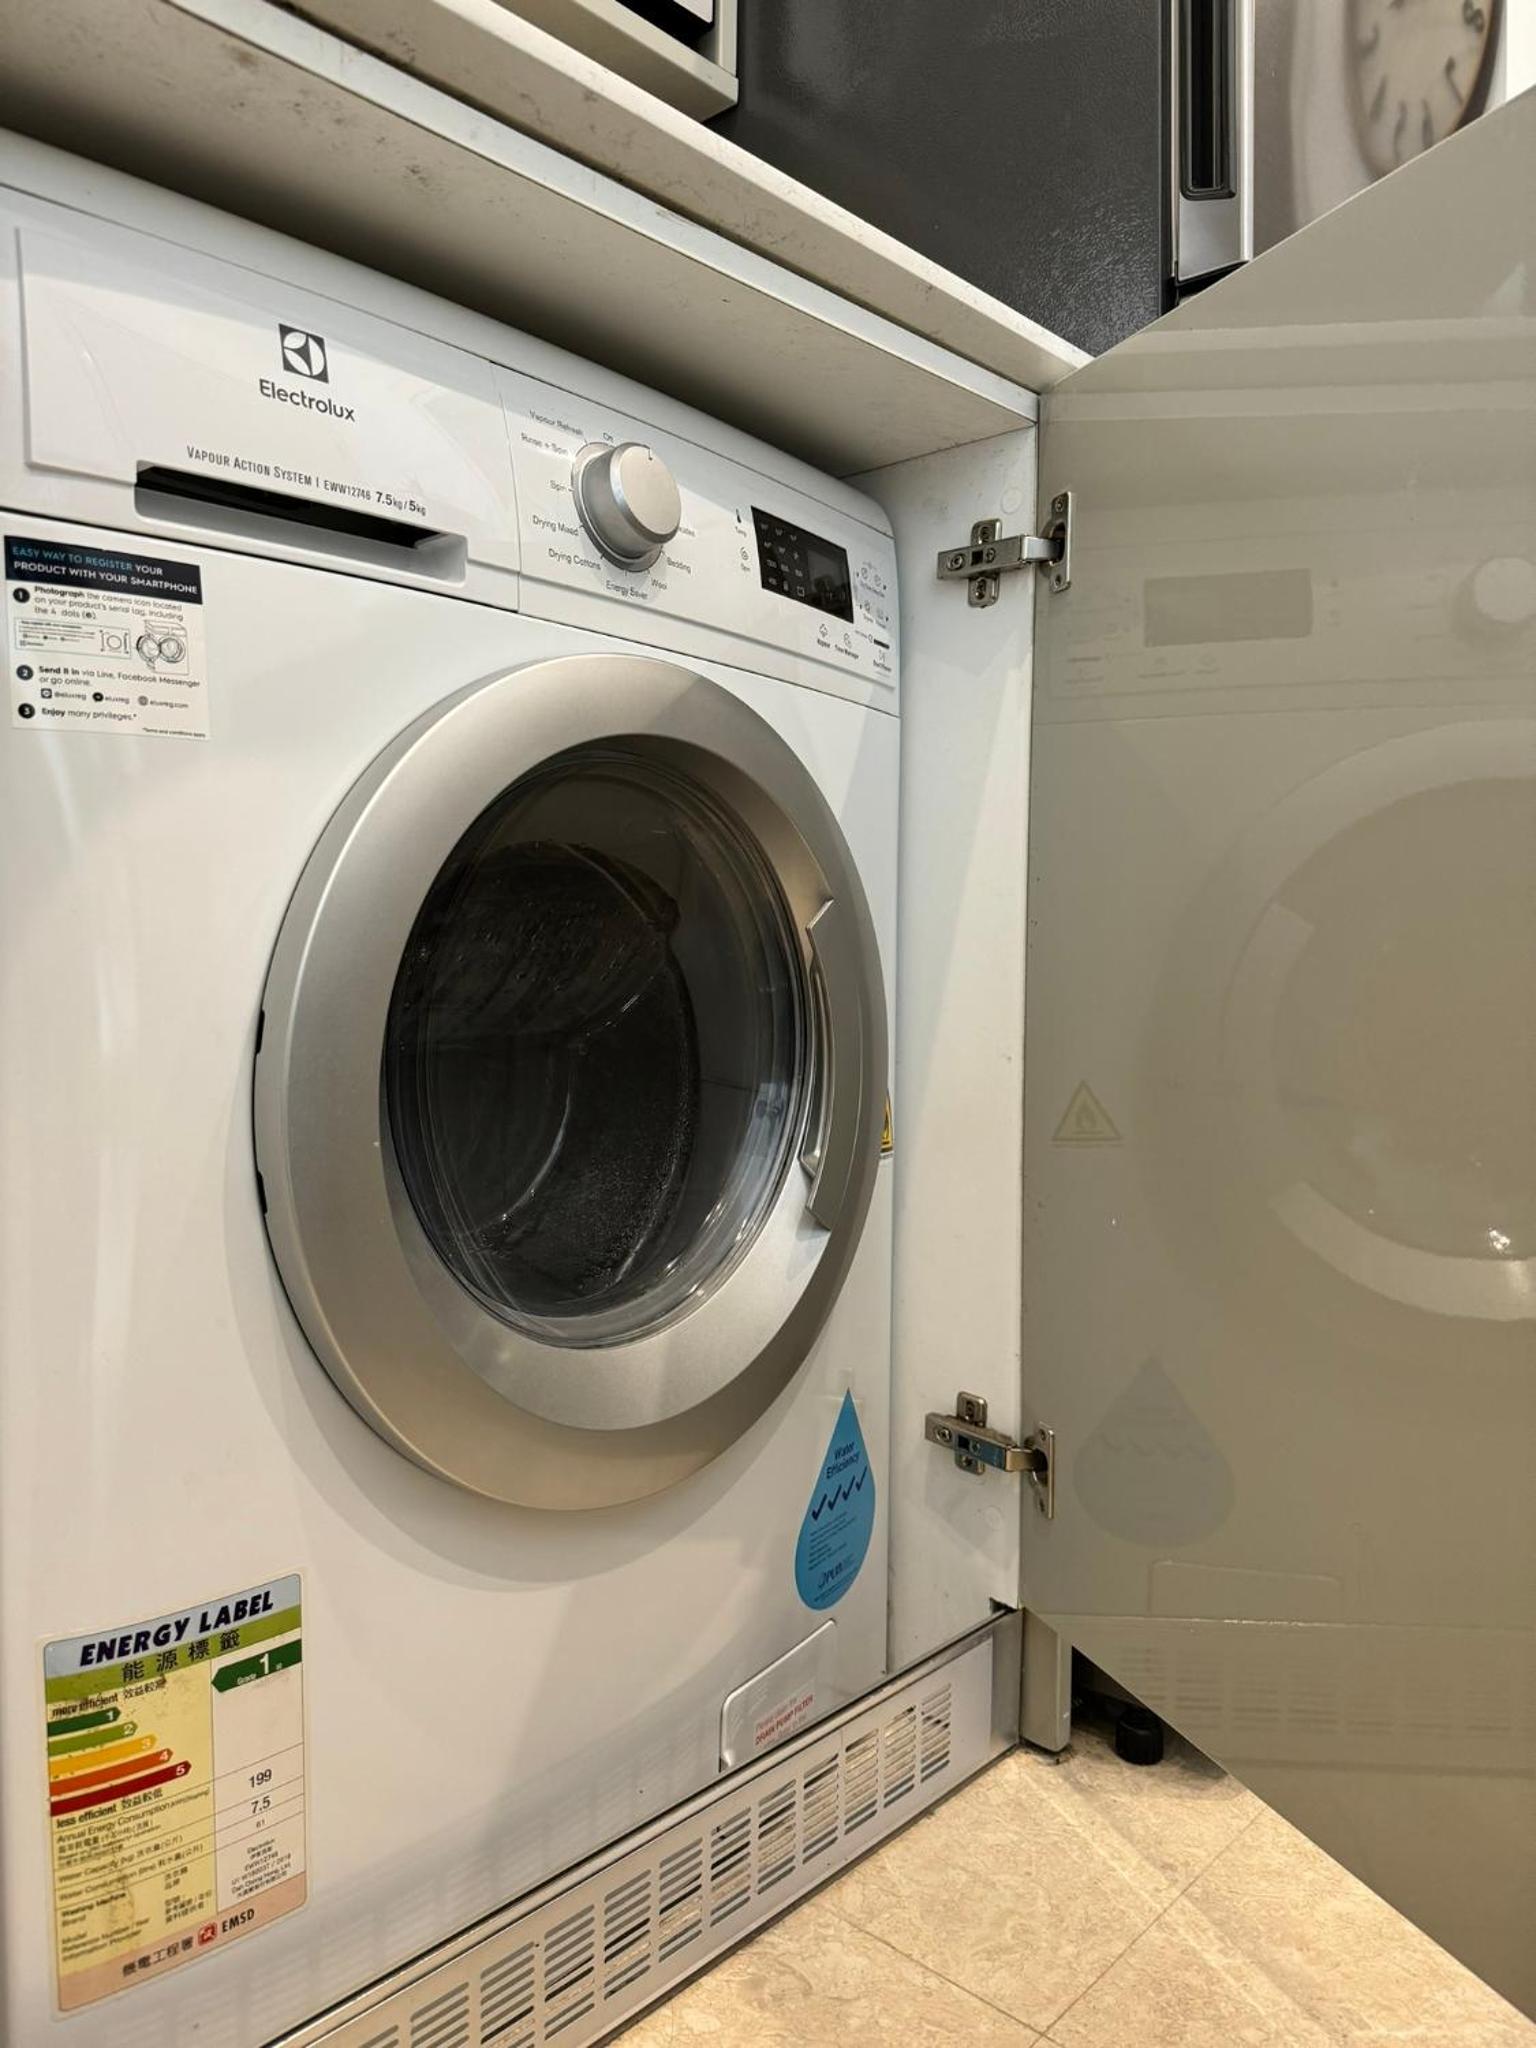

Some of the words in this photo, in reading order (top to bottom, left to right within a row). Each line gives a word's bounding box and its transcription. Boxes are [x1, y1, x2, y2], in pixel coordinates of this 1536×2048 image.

[259, 378, 356, 422] Electrolux
[324, 479, 371, 501] EWW12746
[533, 514, 556, 531] Drying
[12, 546, 40, 558] EASY
[42, 550, 66, 561] WAY
[68, 554, 83, 564] TO
[85, 556, 133, 571] REGISTER
[135, 564, 164, 576] YOUR
[548, 548, 572, 565] Drying
[14, 561, 67, 575] PRODUCT
[68, 568, 97, 579] WITH
[98, 572, 128, 584] YOUR
[130, 576, 198, 595] SMARTPHONE
[34, 586, 86, 598] Photograph
[606, 580, 629, 597] Energy
[39, 665, 61, 675] Send
[118, 672, 157, 683] Facebook
[159, 676, 200, 688] Messenger
[42, 707, 65, 717] Enjoy
[68, 710, 91, 719] many
[834, 1441, 855, 1460] Water
[826, 1451, 860, 1479] Efficiency
[80, 1617, 191, 1667] ENERGY
[199, 1590, 274, 1634] LABEL
[122, 1629, 240, 1683] 能源標籤
[260, 1653, 269, 1675] 1
[106, 1711, 114, 1721] 1
[124, 1725, 133, 1735] 2
[142, 1738, 151, 1749] 3
[159, 1751, 168, 1761] 4
[176, 1764, 185, 1775] 5
[248, 1768, 272, 1788] 199
[250, 1795, 271, 1814] 7.5
[56, 1816, 76, 1829] less
[78, 1804, 117, 1822] efficient
[58, 1829, 86, 1842] Annual
[87, 1821, 115, 1837] Energy
[117, 1803, 170, 1825] Consumption
[221, 1907, 256, 1934] EMSD
